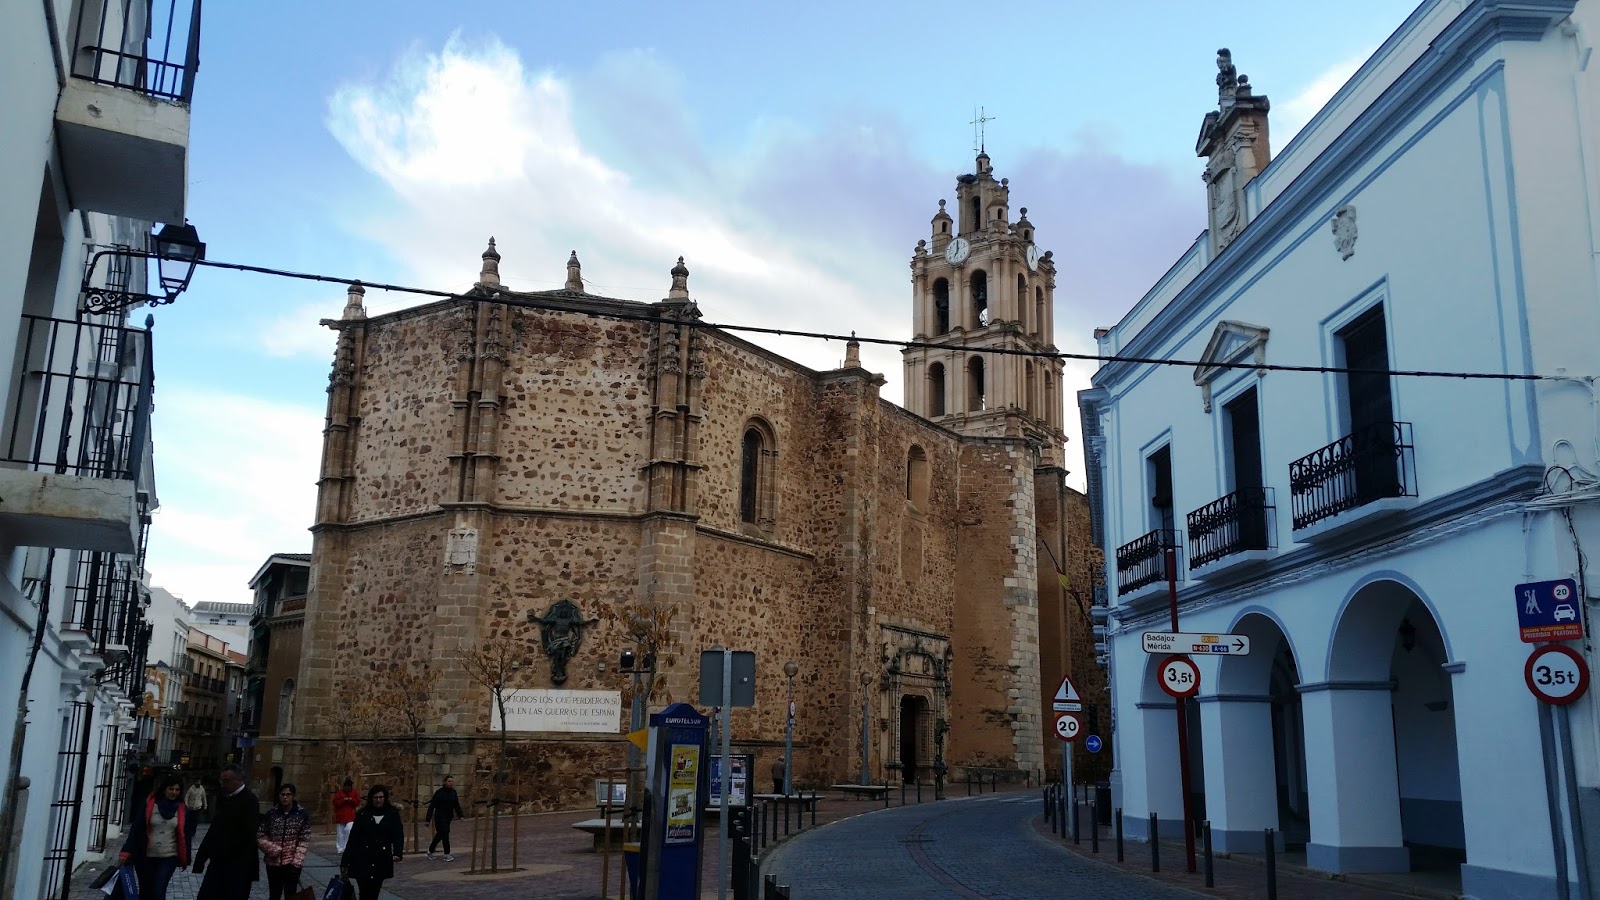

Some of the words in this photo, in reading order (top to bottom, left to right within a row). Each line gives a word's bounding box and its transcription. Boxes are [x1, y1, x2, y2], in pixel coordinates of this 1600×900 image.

[1146, 634, 1175, 642] Badajoz
[1147, 642, 1171, 650] Mérida
[513, 695, 538, 704] TODOS
[540, 696, 554, 704] LOS
[555, 697, 571, 705] QUE
[573, 697, 610, 705] PERDIERON
[611, 697, 620, 705] SU
[517, 707, 527, 715] EN
[529, 707, 543, 715] LAS
[545, 707, 578, 716] GUERRAS
[580, 708, 589, 716] DE
[591, 707, 615, 717] ESPAÑA
[665, 717, 702, 725] EUROTELSUR
[1059, 721, 1077, 731] 20
